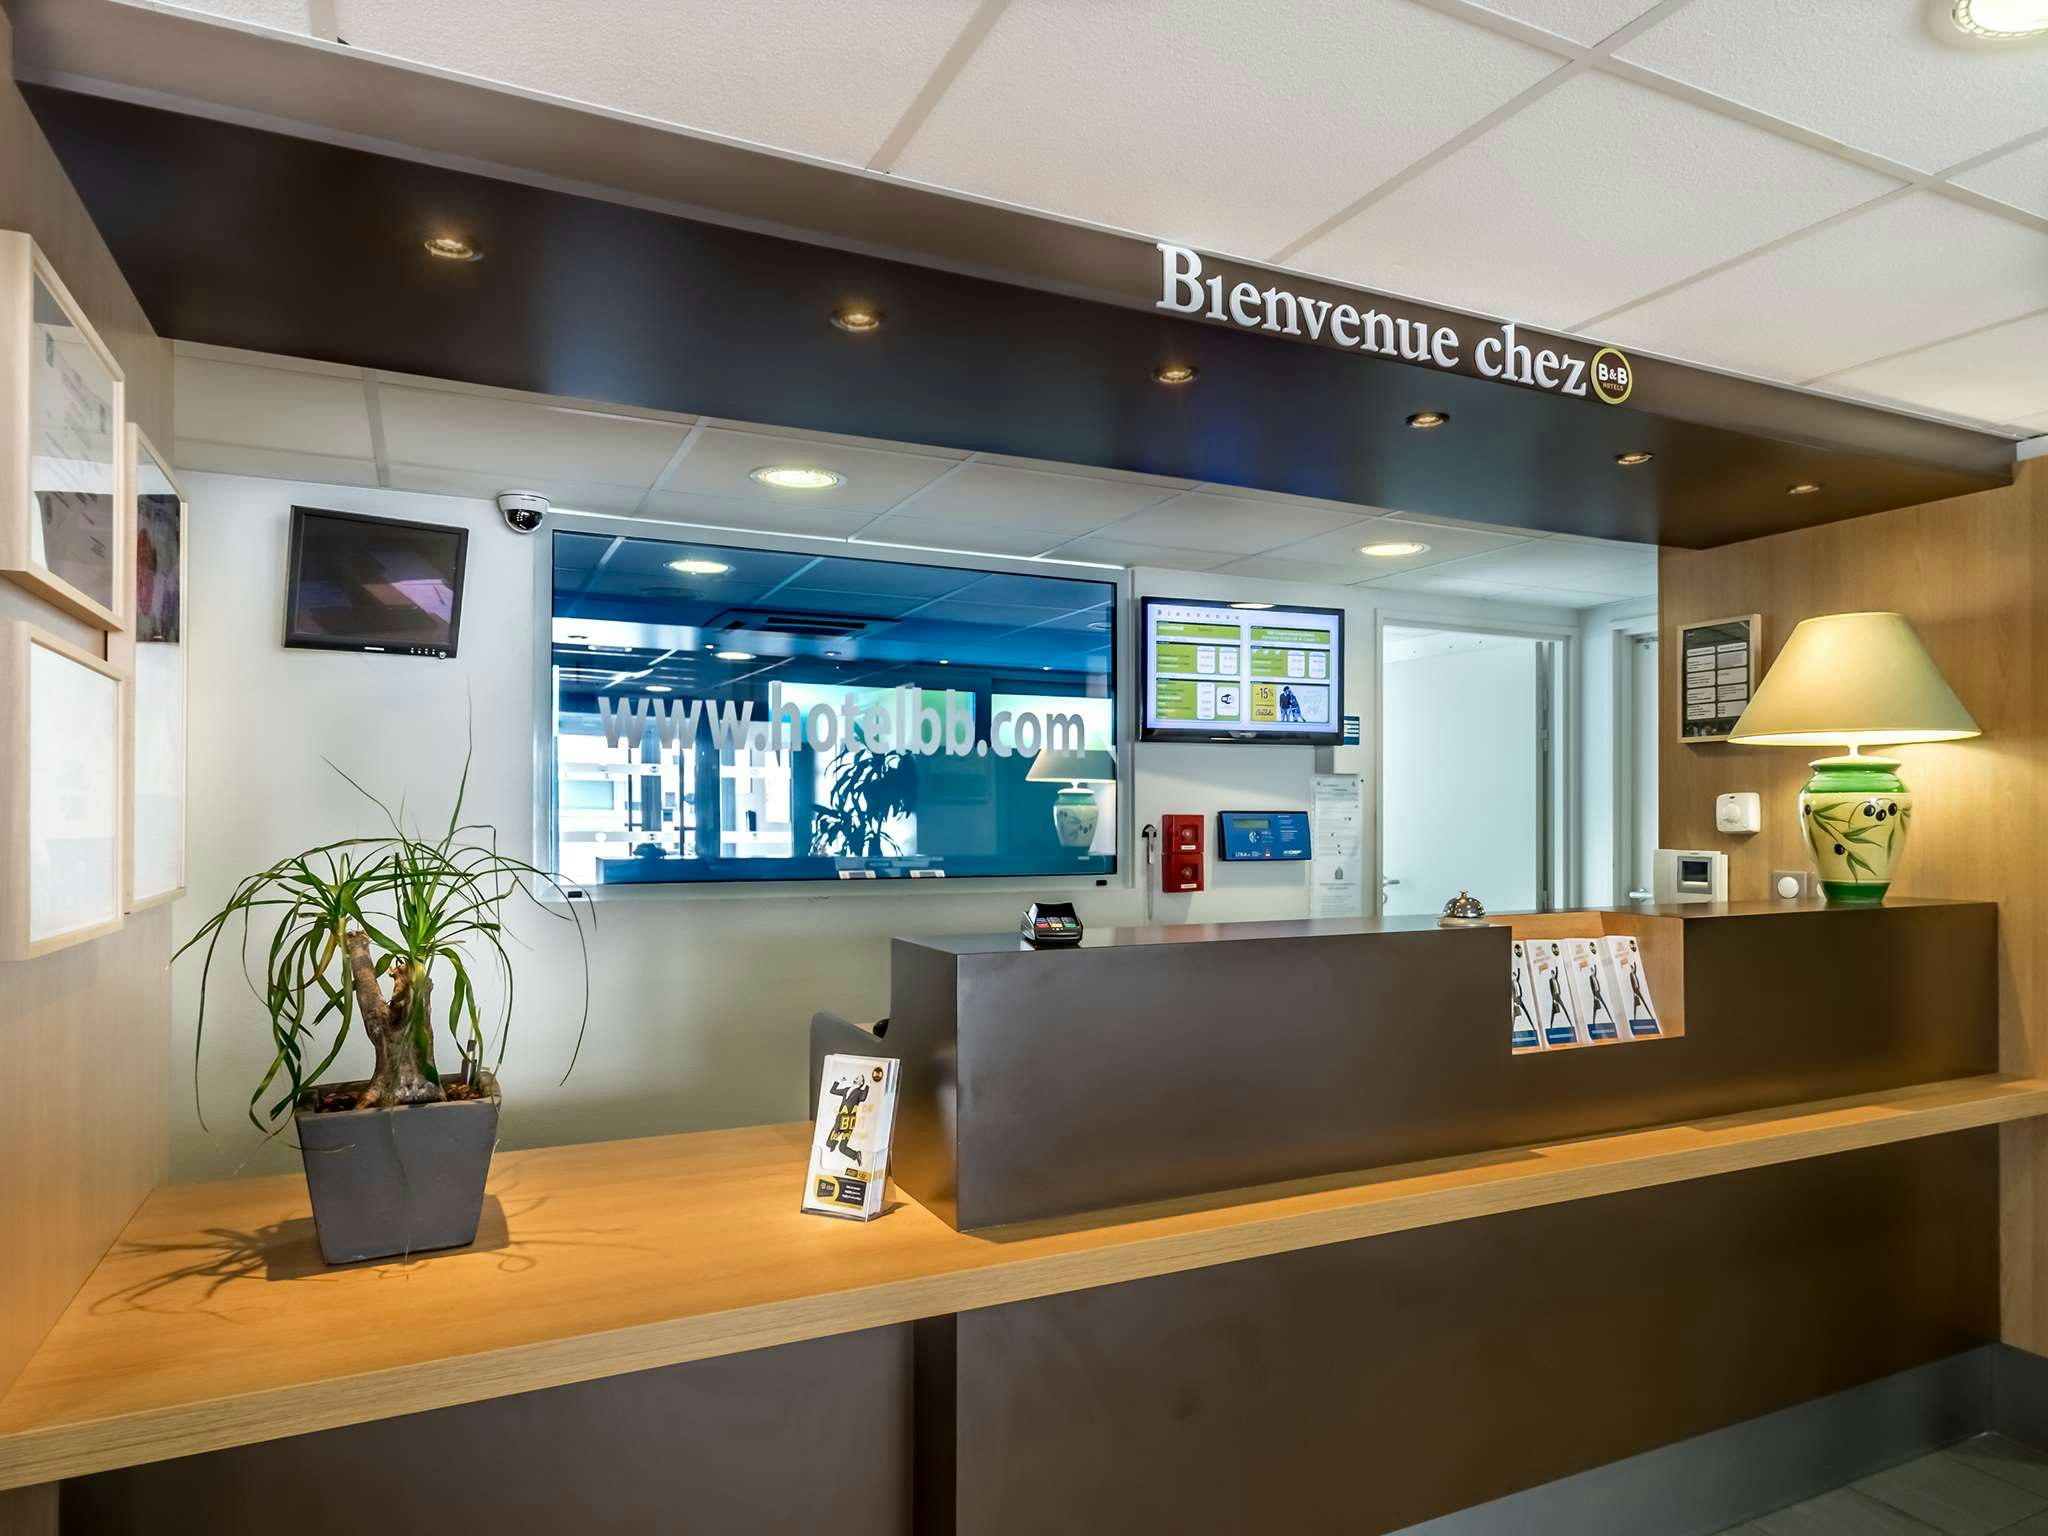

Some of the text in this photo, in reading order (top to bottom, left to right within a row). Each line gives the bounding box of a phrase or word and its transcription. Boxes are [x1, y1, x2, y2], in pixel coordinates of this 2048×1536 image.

[1156, 242, 1587, 397] Bienvenue chez
[1598, 362, 1628, 385] B&B
[1602, 381, 1624, 392] HOTELS
[598, 680, 1086, 759] www.hotelbb.com
